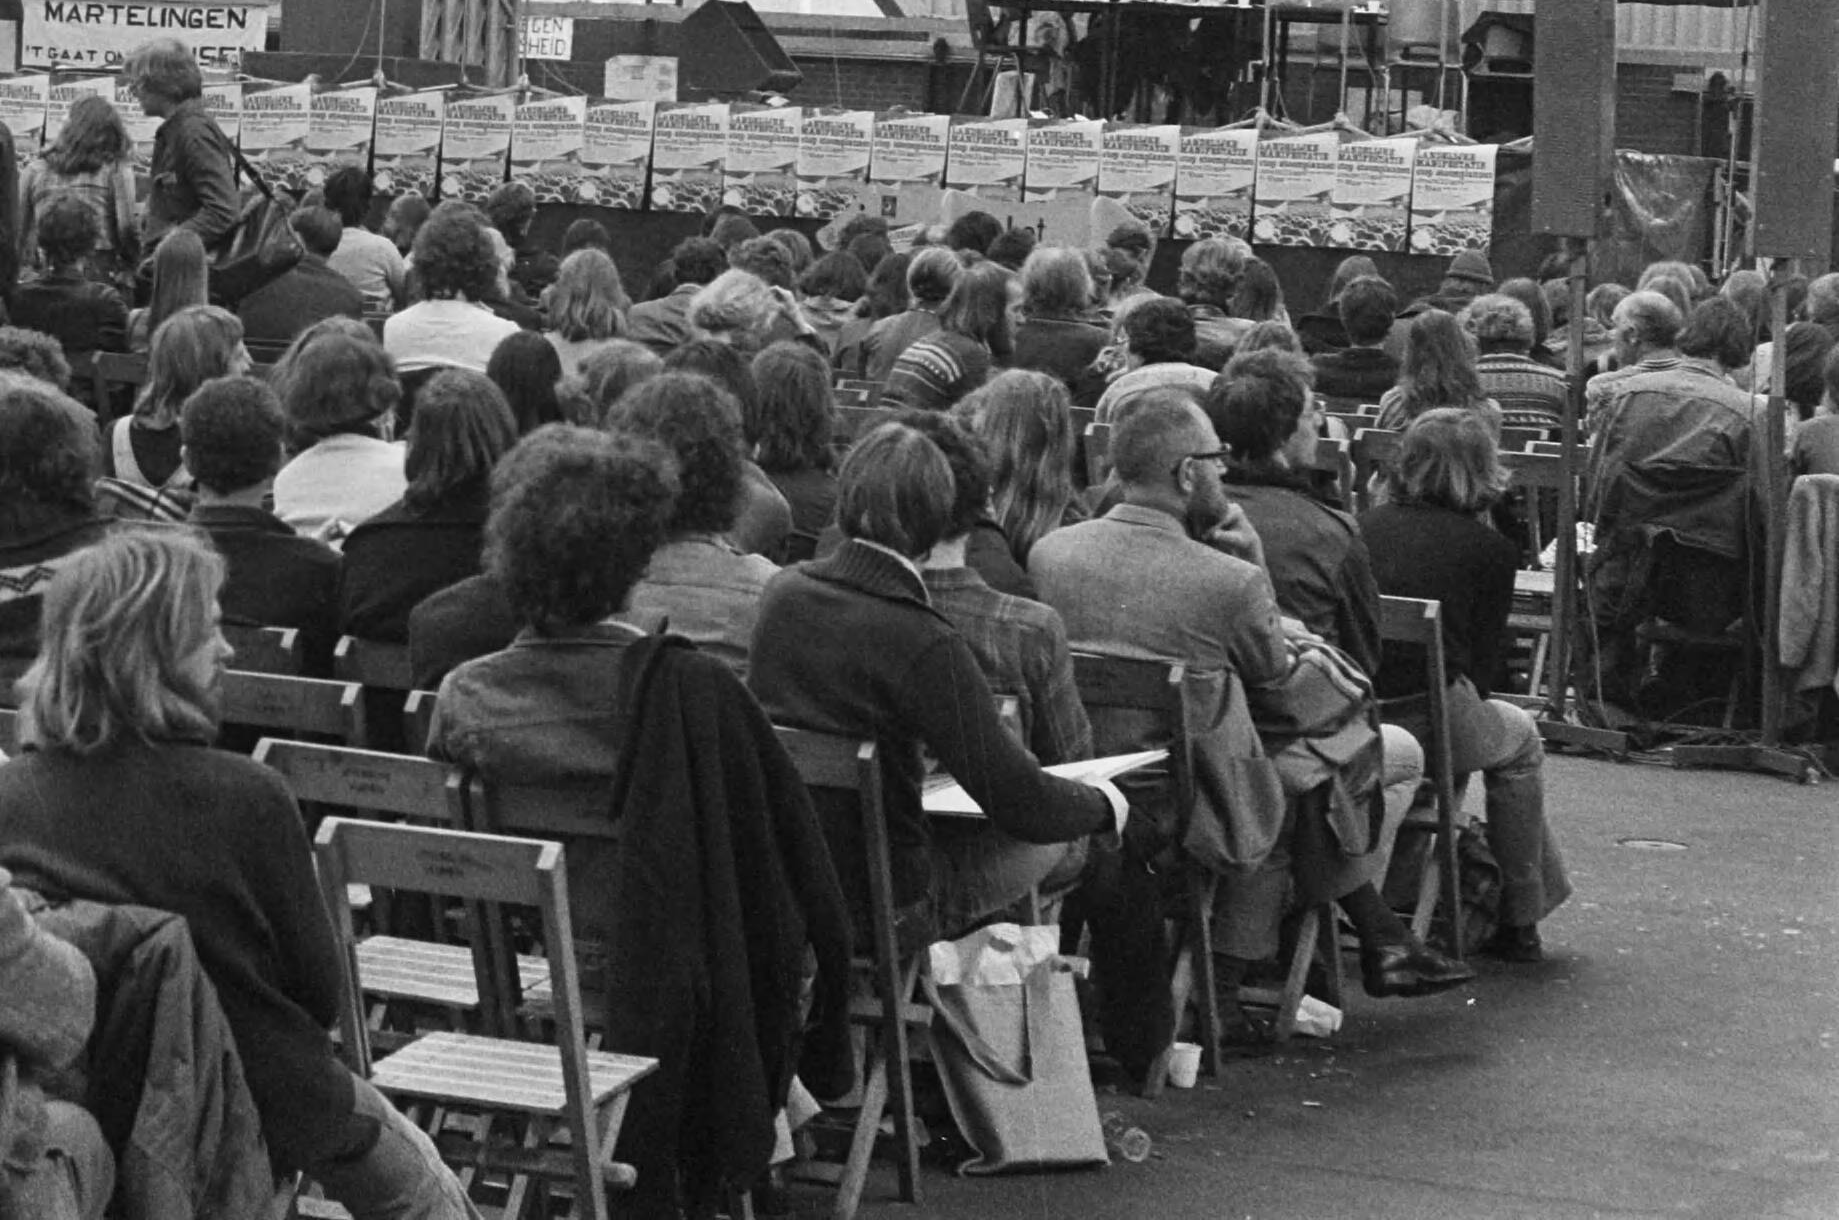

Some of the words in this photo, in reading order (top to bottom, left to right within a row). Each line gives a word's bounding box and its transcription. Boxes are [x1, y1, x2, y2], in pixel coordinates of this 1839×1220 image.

[44, 0, 248, 29] MARTELINGEN
[25, 45, 43, 58] 'T
[48, 47, 98, 62] GAAT
